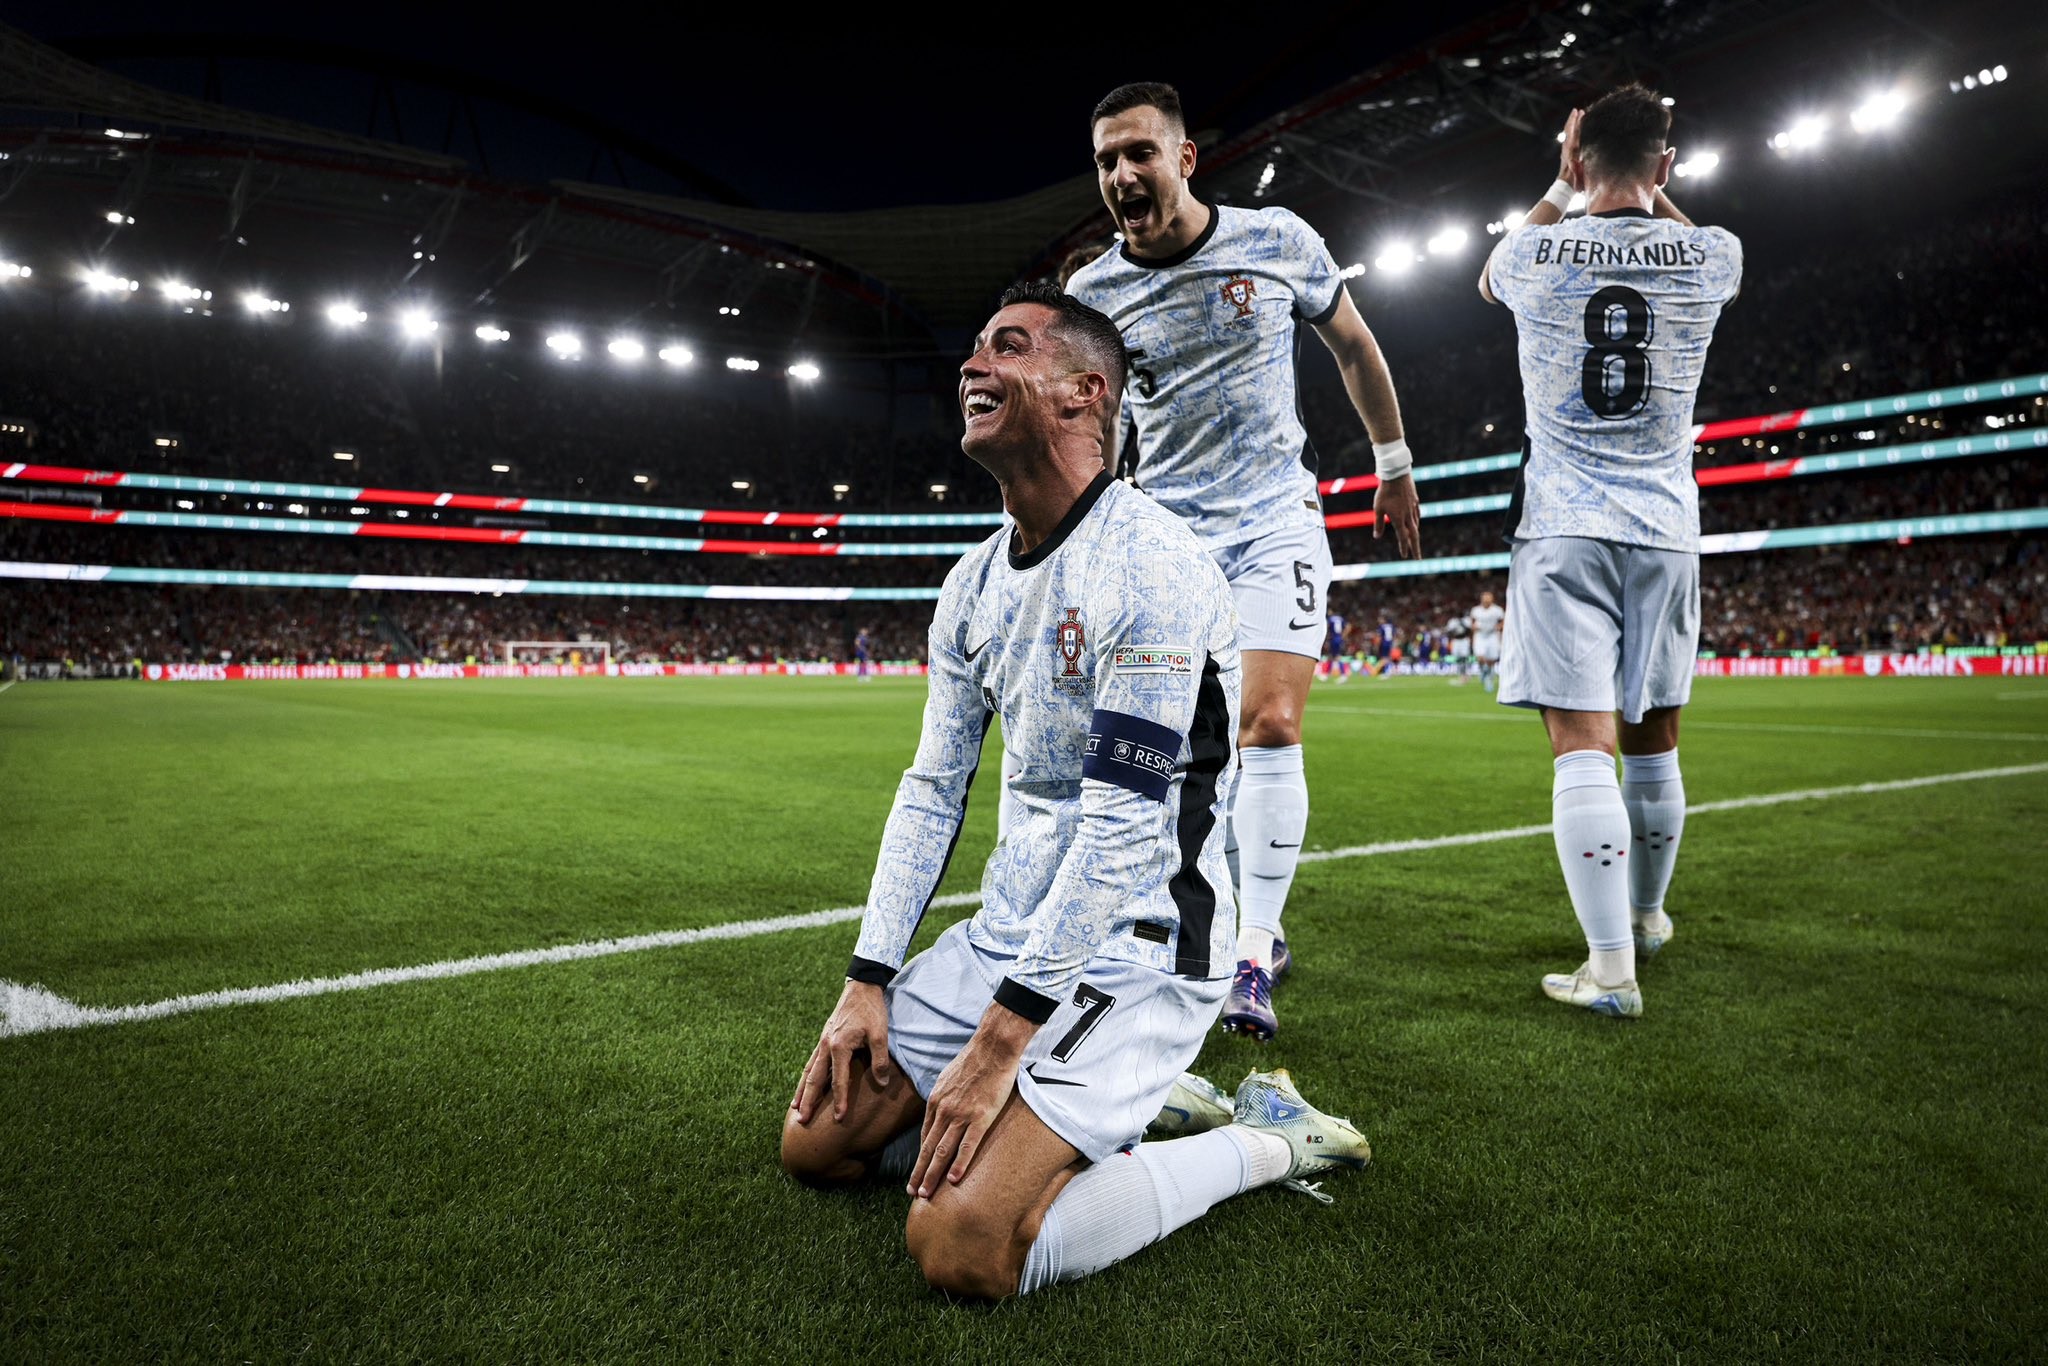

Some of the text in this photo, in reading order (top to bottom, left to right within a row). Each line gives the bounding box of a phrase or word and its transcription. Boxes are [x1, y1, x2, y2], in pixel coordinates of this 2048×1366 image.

[1535, 238, 1706, 266] B.FERNANDES
[1581, 285, 1654, 421] 8
[1127, 348, 1159, 400] 5
[1293, 560, 1316, 616] 5
[1115, 647, 1134, 655] UEFA
[1116, 654, 1191, 665] FOUNDATION
[1889, 653, 1973, 676] SAGRES
[168, 664, 227, 681] SAGRES
[1050, 982, 1116, 1063] 7
